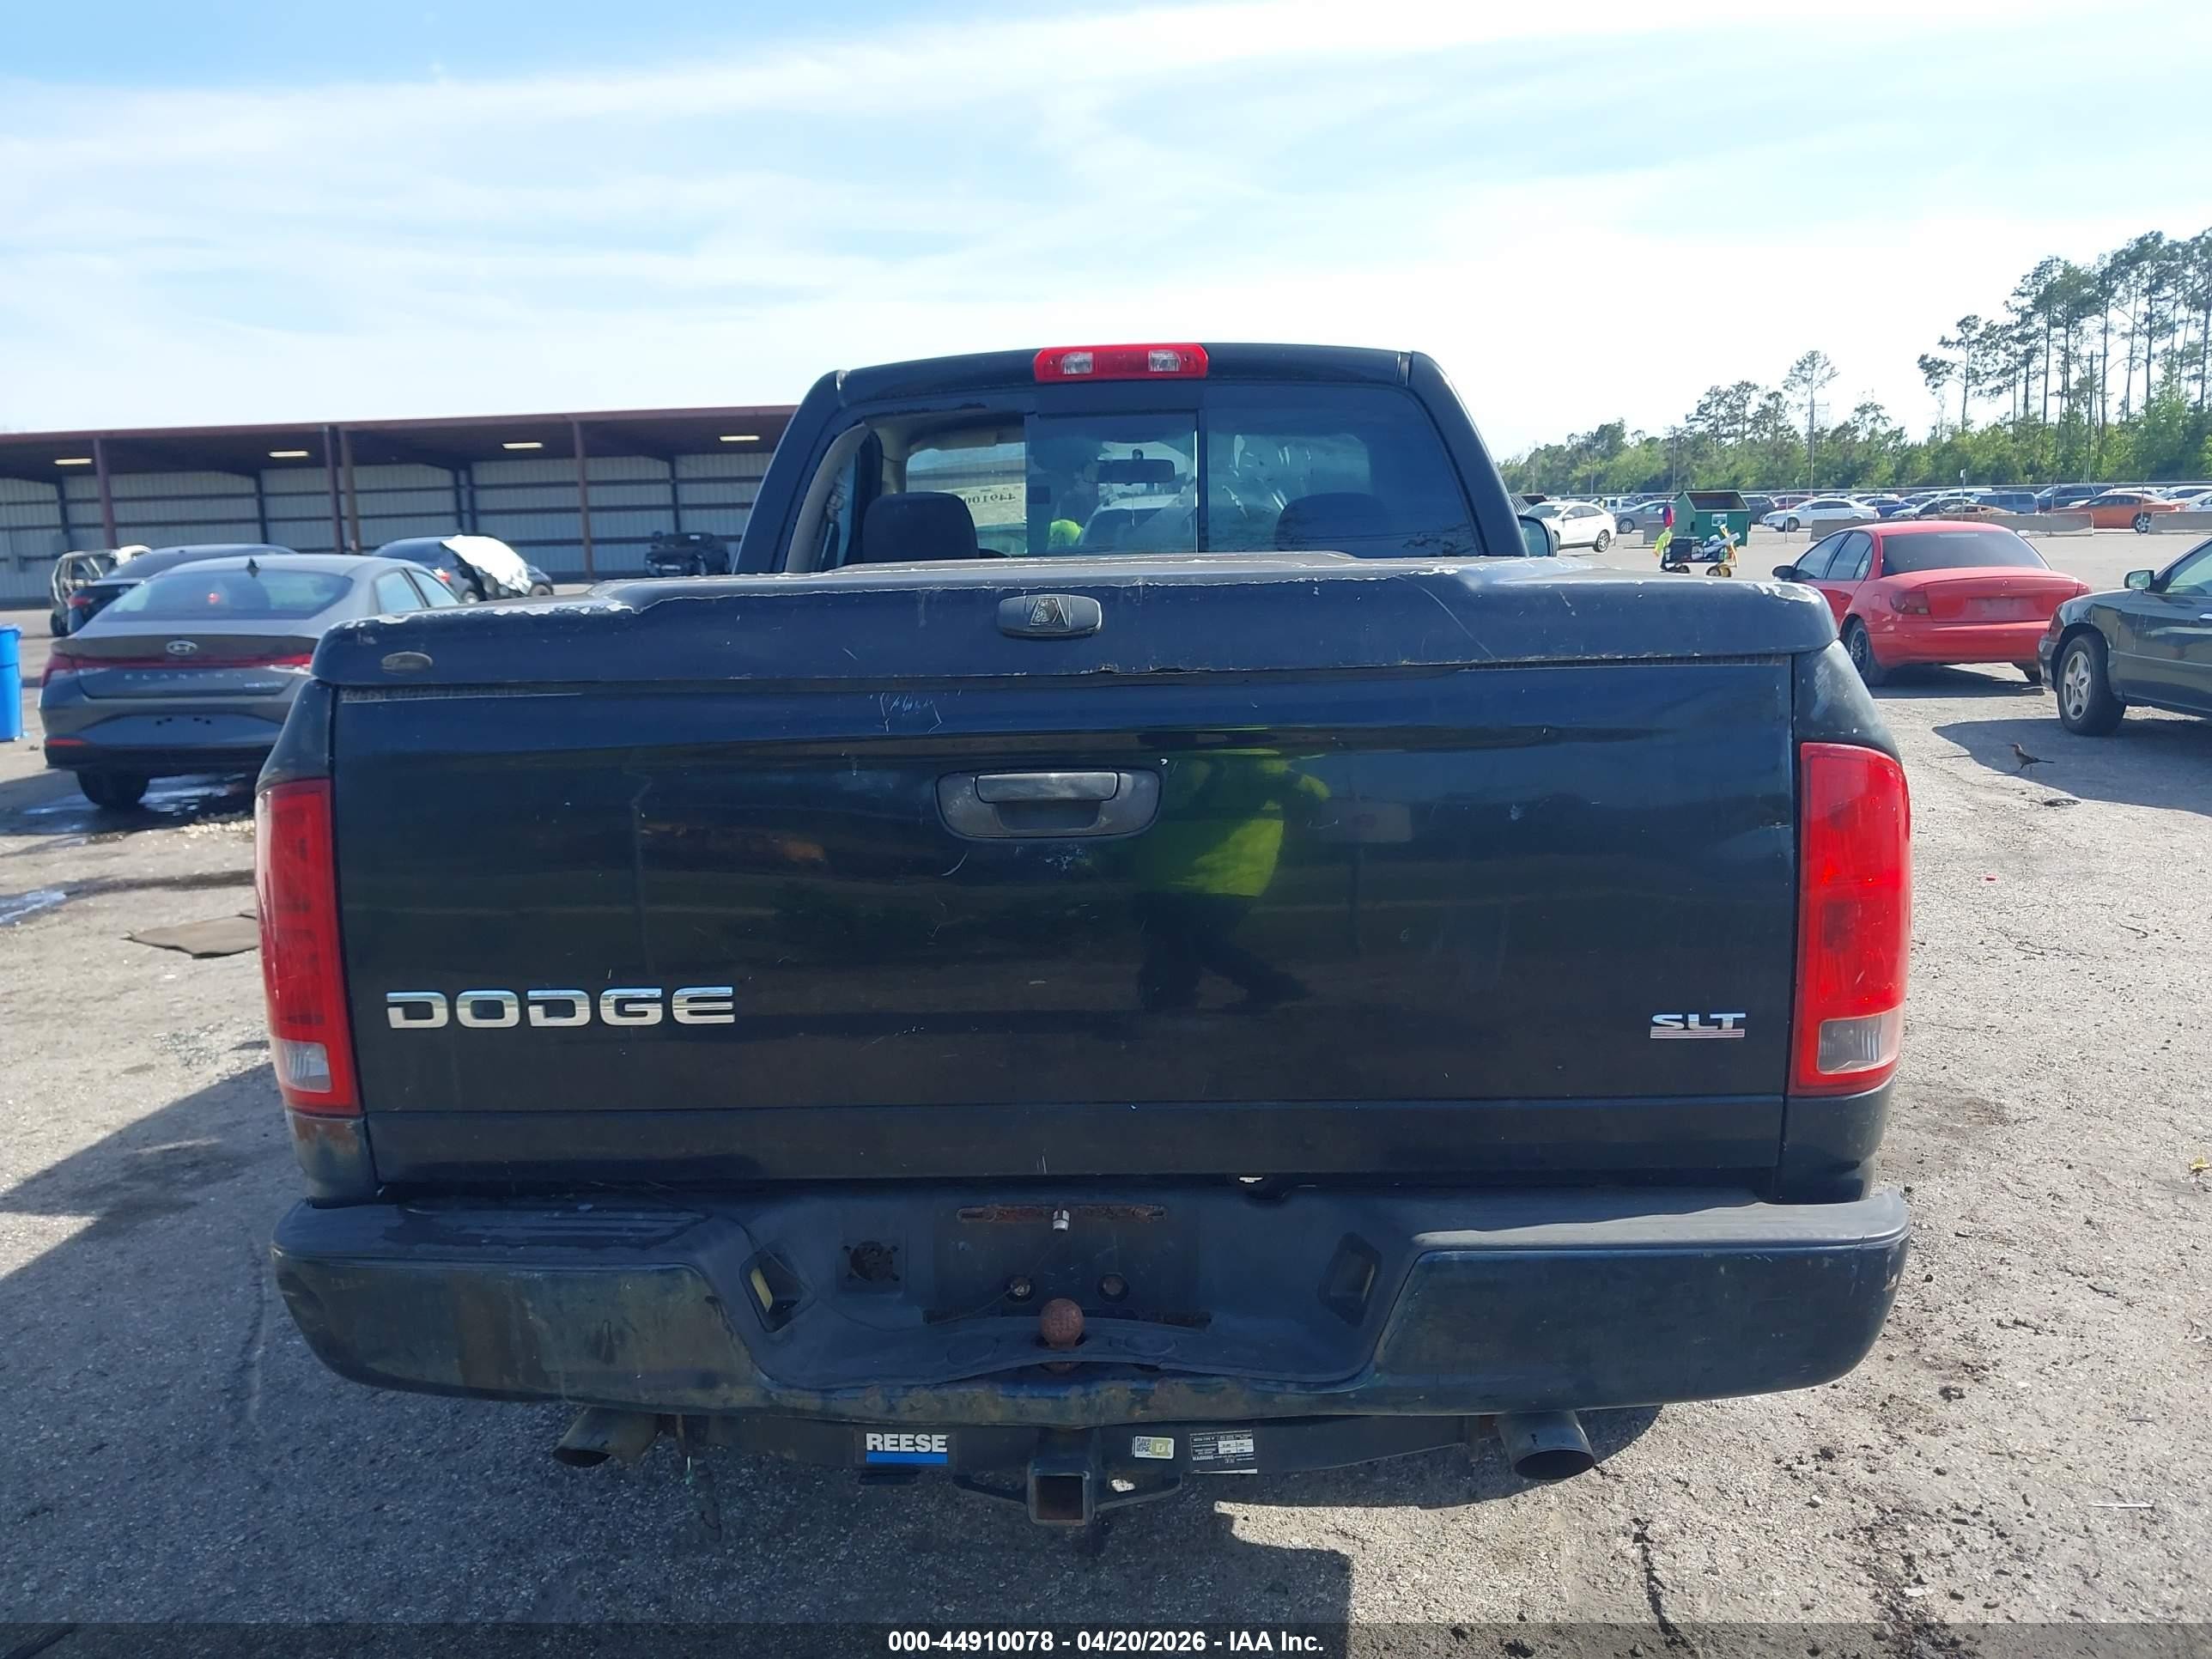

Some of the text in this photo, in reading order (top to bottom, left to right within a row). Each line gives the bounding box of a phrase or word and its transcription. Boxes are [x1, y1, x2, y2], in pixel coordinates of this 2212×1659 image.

[386, 987, 736, 1029] DODGE
[1650, 1012, 1746, 1031] SLT
[866, 1432, 948, 1452] REESE
